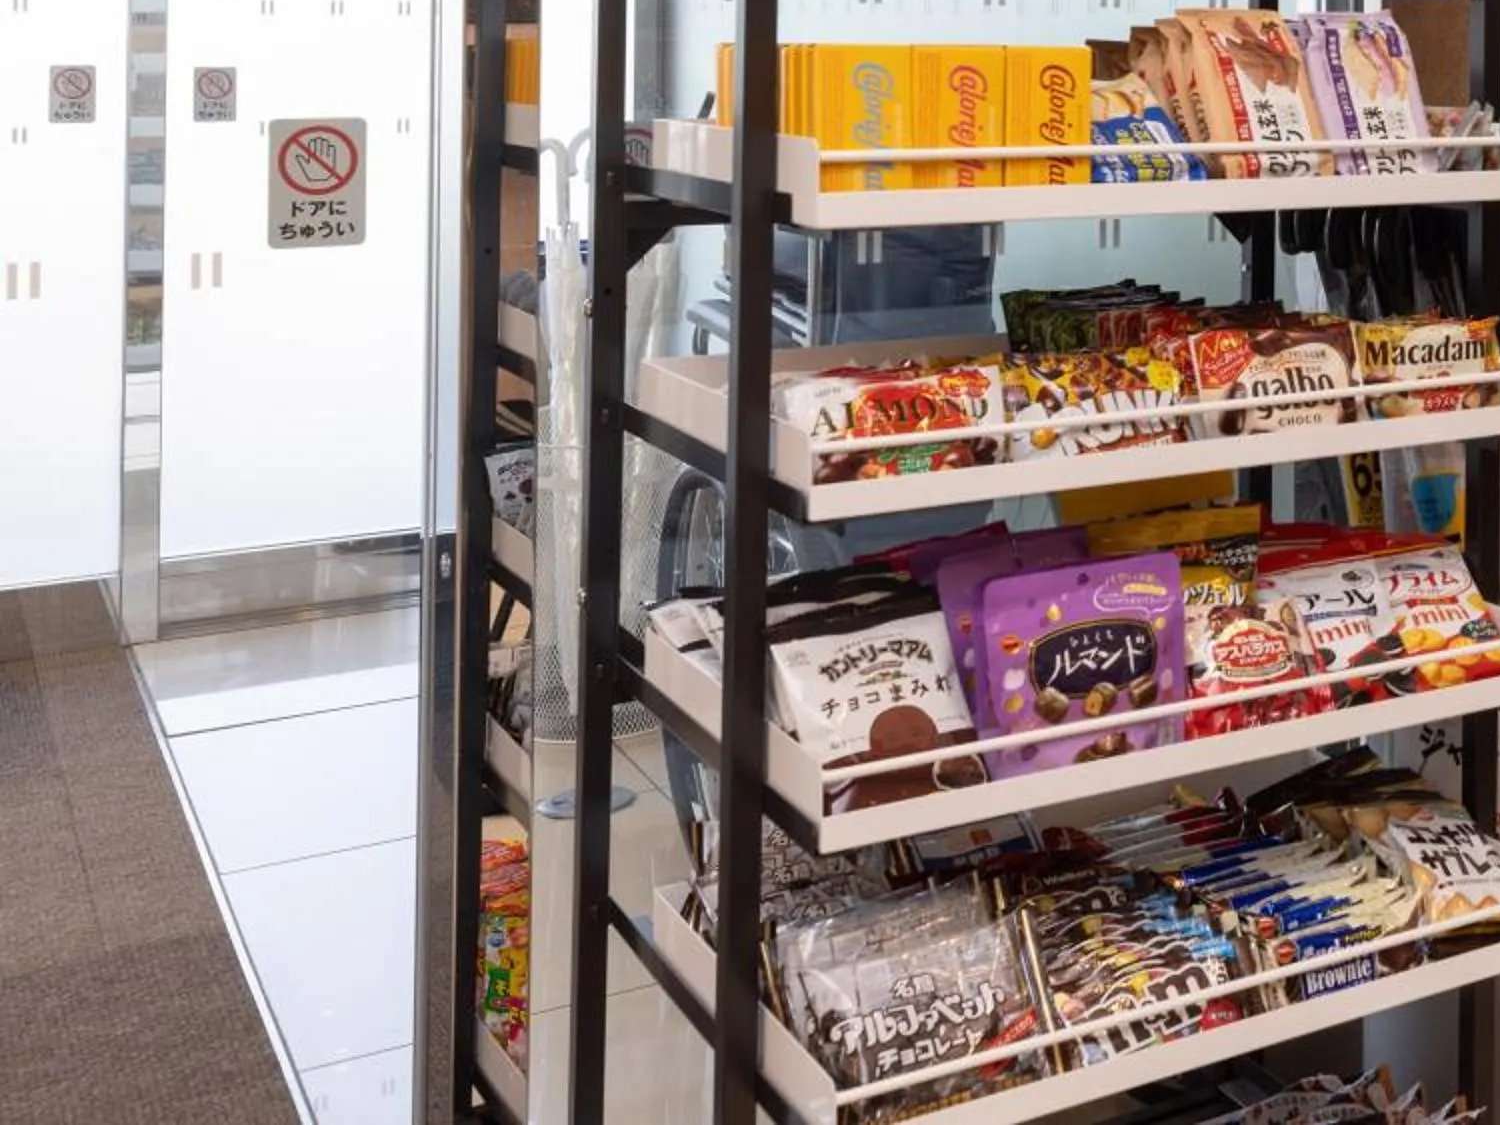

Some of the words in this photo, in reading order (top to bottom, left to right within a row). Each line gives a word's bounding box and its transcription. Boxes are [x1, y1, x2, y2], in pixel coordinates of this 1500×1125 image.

[949, 64, 988, 148] Calorie
[1040, 64, 1075, 146] Calorie
[279, 221, 355, 240] ちゅうい
[290, 200, 347, 218] ドアに
[1412, 603, 1471, 627] mini
[818, 639, 934, 682] カントリーマアム
[1047, 635, 1146, 686] ルマンド
[821, 673, 953, 720] チョコまみれ
[1307, 958, 1372, 994] Brownie
[830, 981, 1005, 1055] アルファベット
[877, 1028, 984, 1070] チョコレート
